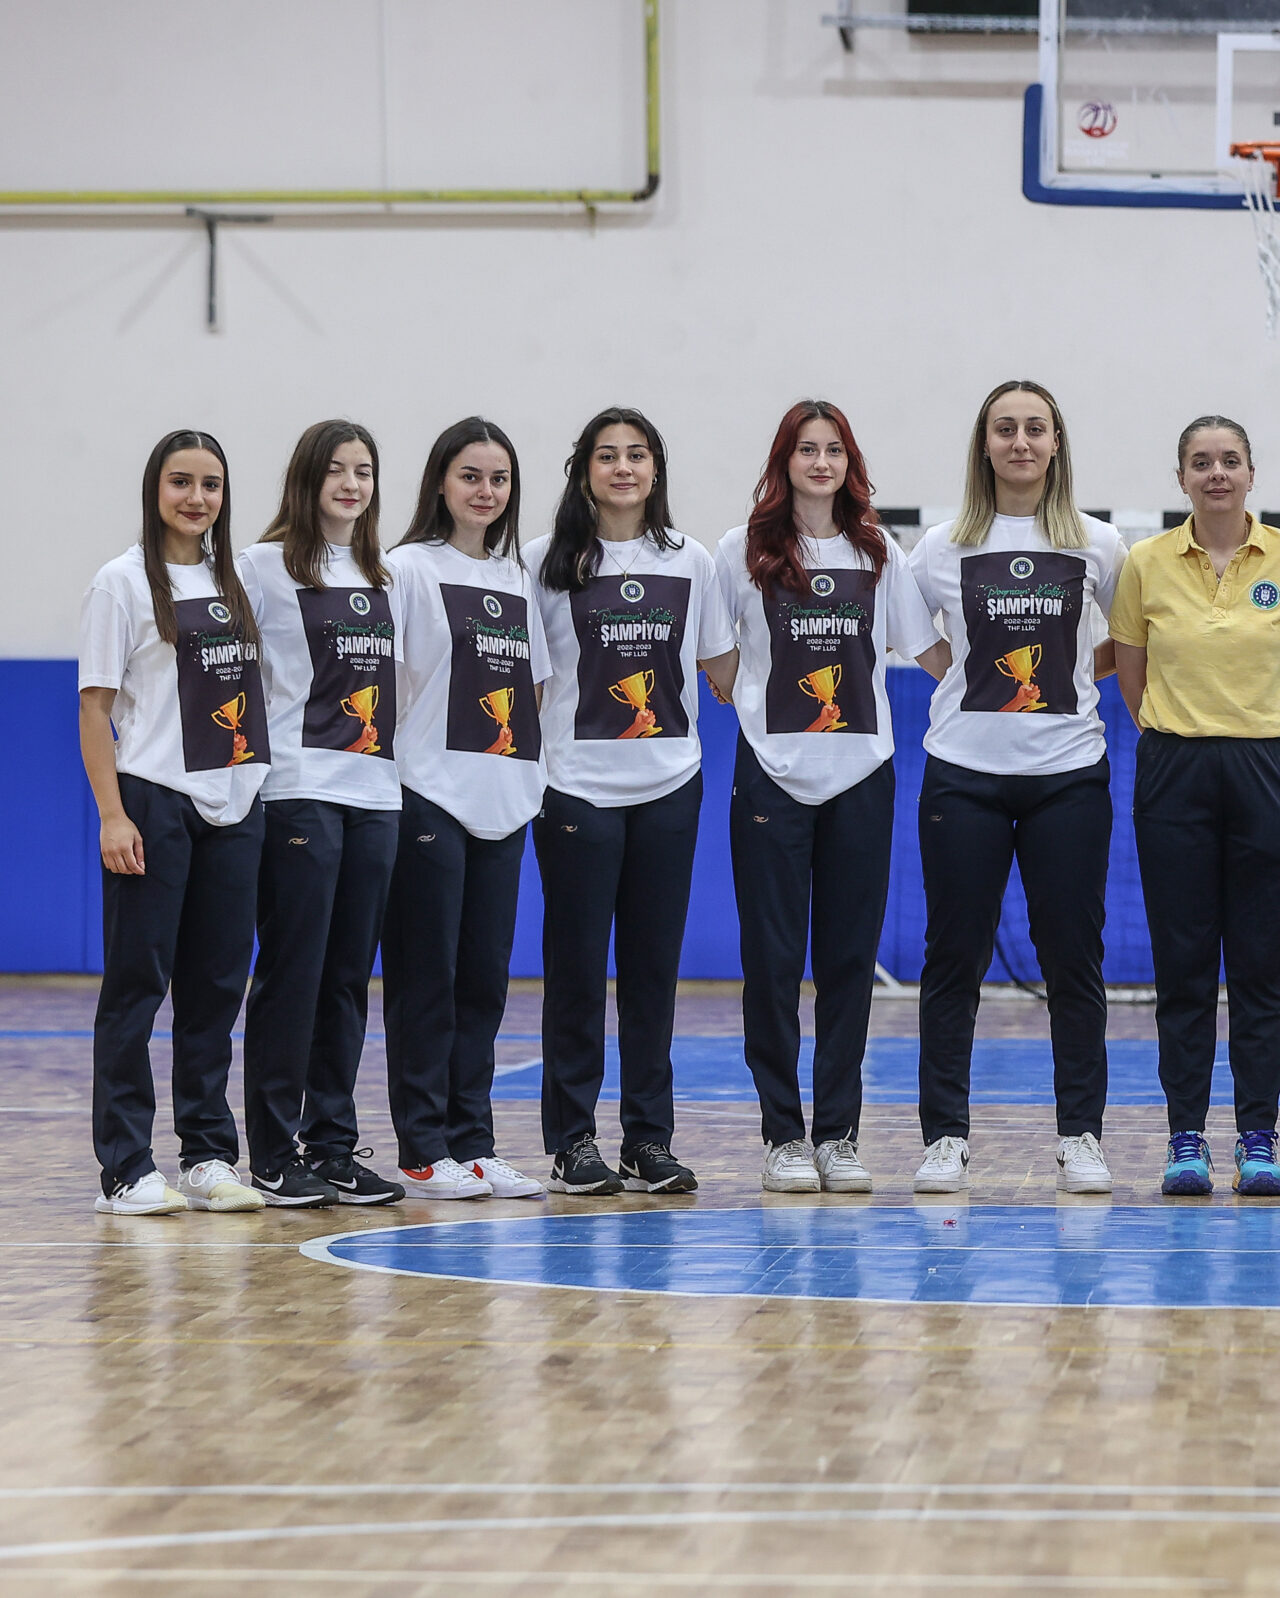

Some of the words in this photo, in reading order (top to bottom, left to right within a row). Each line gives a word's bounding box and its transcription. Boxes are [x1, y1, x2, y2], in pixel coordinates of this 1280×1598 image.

[987, 594, 1063, 621] ŞAMPİYON
[600, 619, 671, 648] ŞAMPİYON
[790, 614, 859, 641] ŞAMPİYON
[336, 633, 392, 660] ŞAMPİYON
[476, 633, 530, 660] ŞAMPİYON
